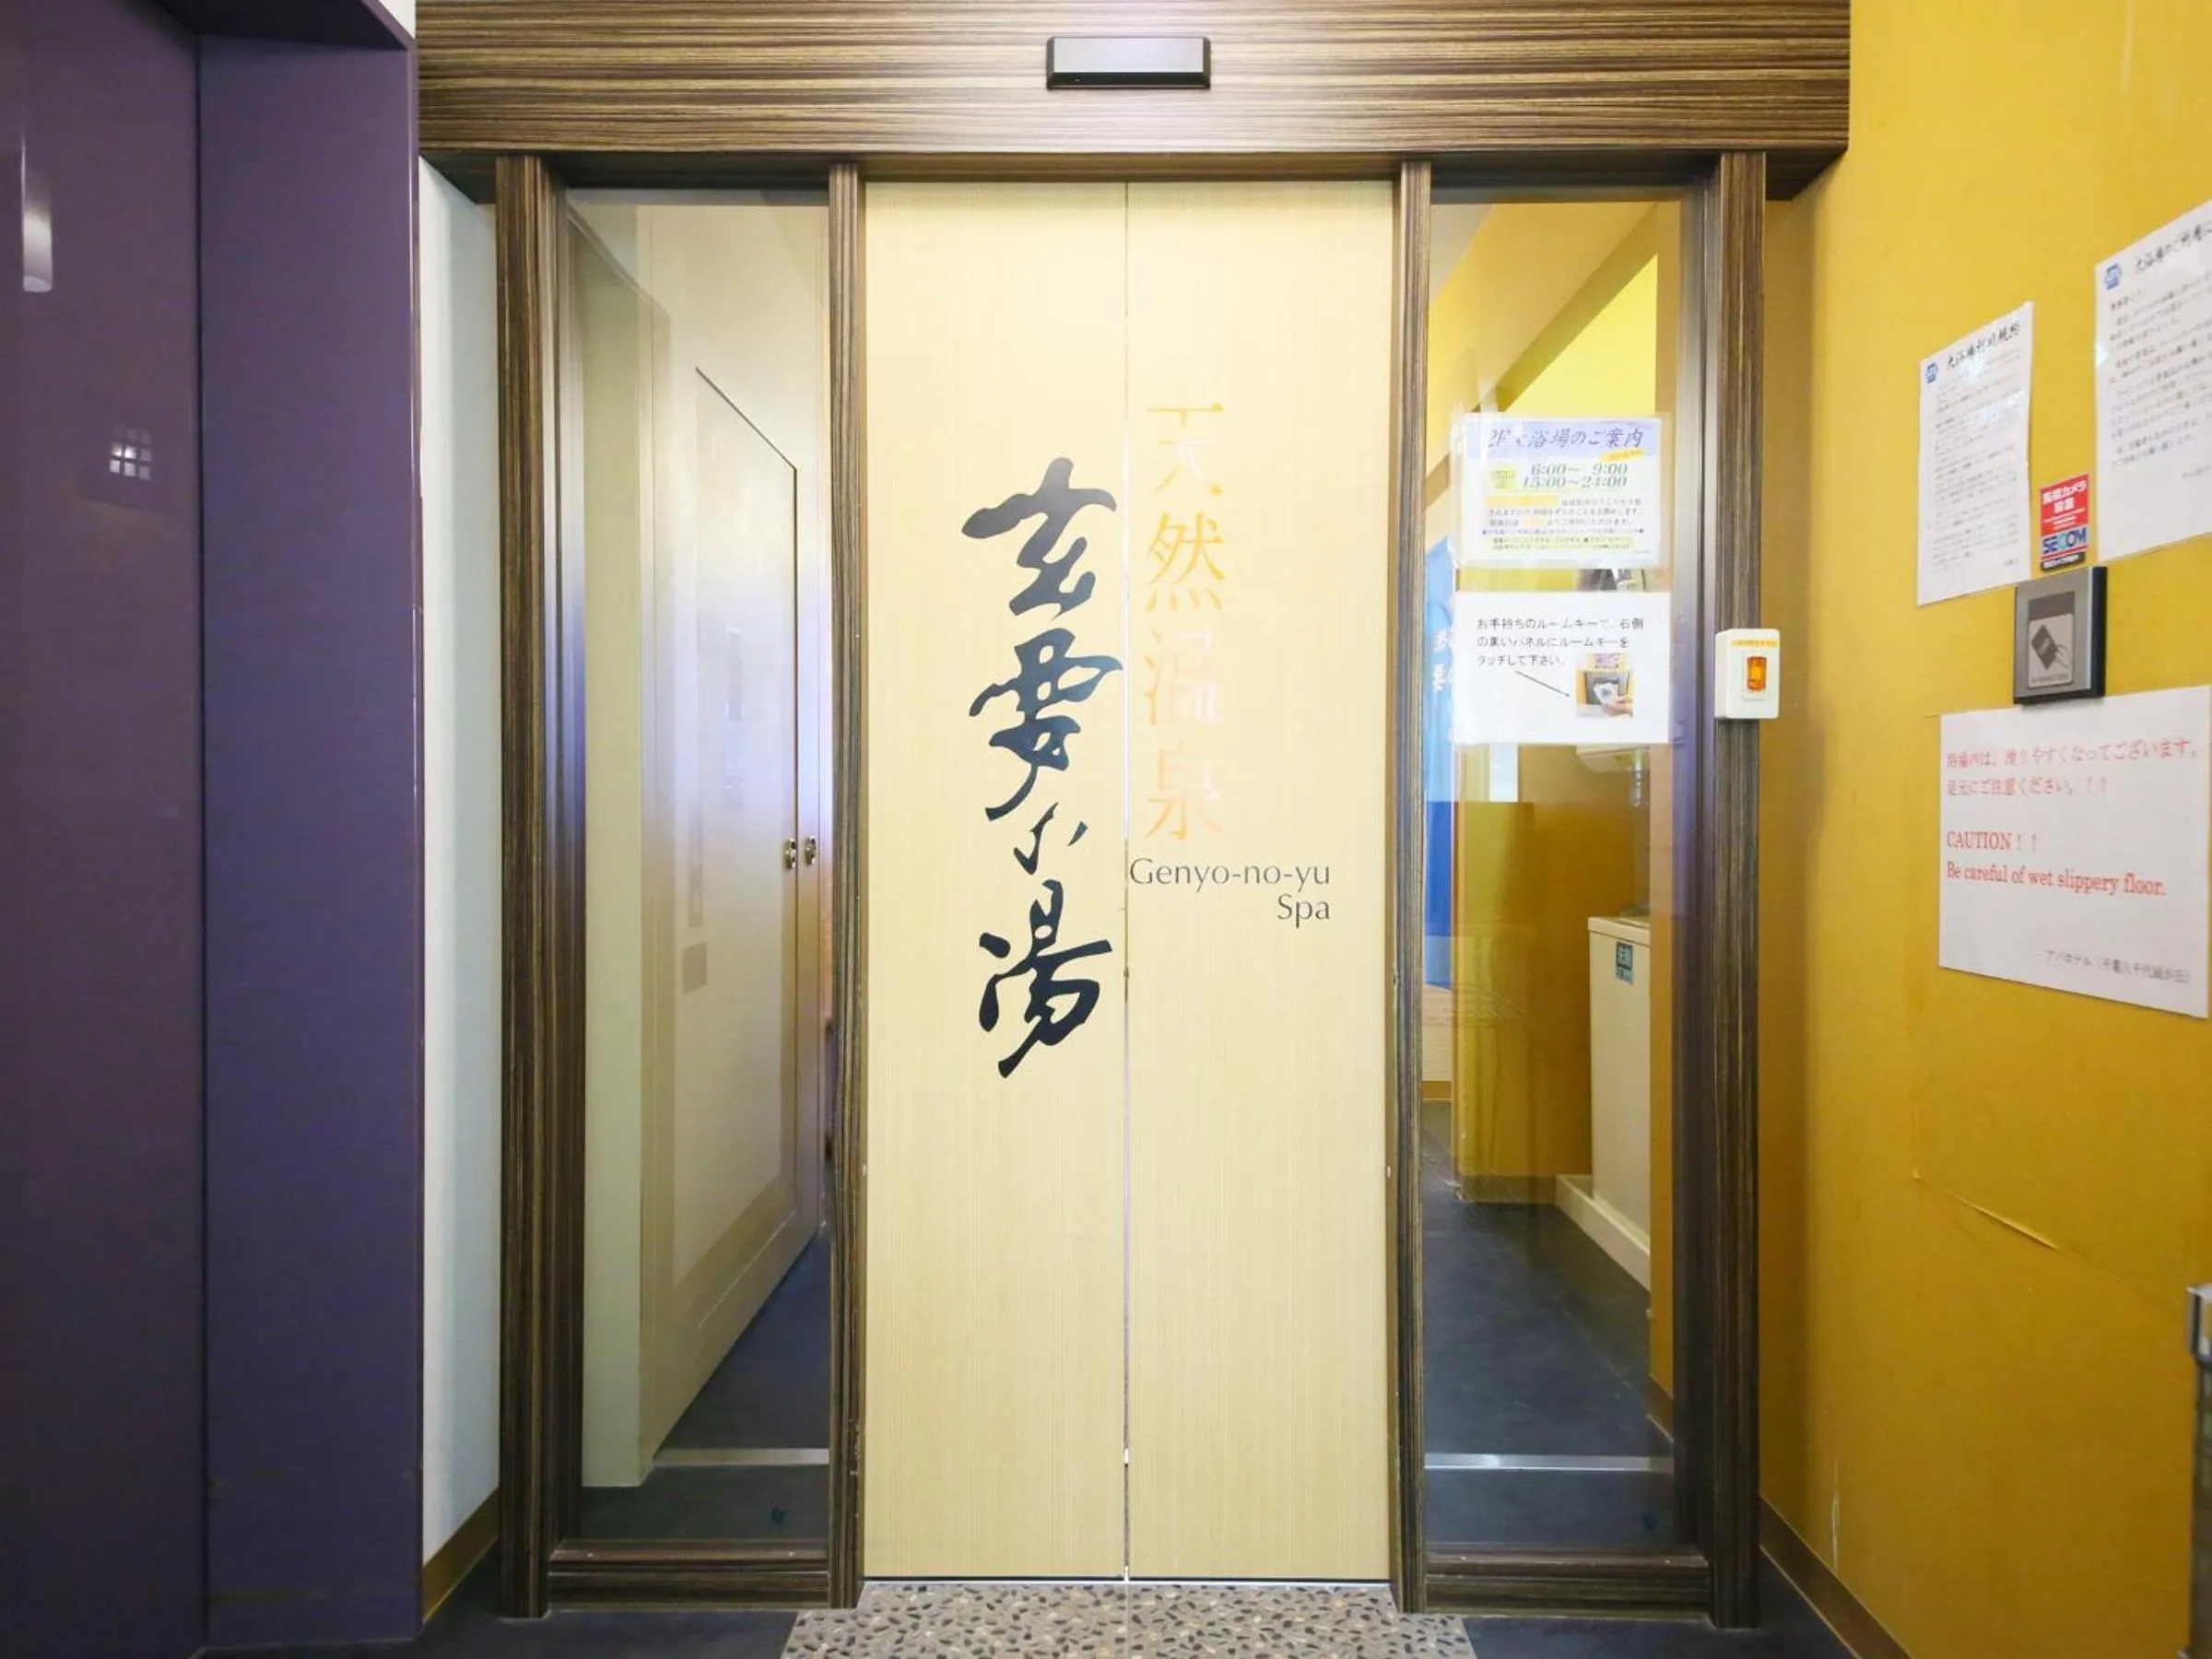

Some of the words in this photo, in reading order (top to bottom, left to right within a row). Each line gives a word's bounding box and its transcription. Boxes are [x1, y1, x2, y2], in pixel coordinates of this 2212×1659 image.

[2042, 527, 2087, 554] SECOM
[1144, 401, 1225, 841] 天然温泉
[1476, 616, 1644, 630] お手持ちのルームキーで、右側
[1477, 634, 1630, 648] の黒いパネルにルームキーを
[1477, 653, 1565, 666] タッチして下さい。
[1129, 857, 1331, 893] Genyo-no-yu
[1947, 861, 1960, 879] Be
[1964, 865, 2008, 884] careful
[2011, 866, 2025, 885] of
[2028, 870, 2053, 886] wet
[2057, 868, 2119, 896] slippery
[2124, 872, 2168, 896] floor.
[1277, 892, 1331, 928] Spa
